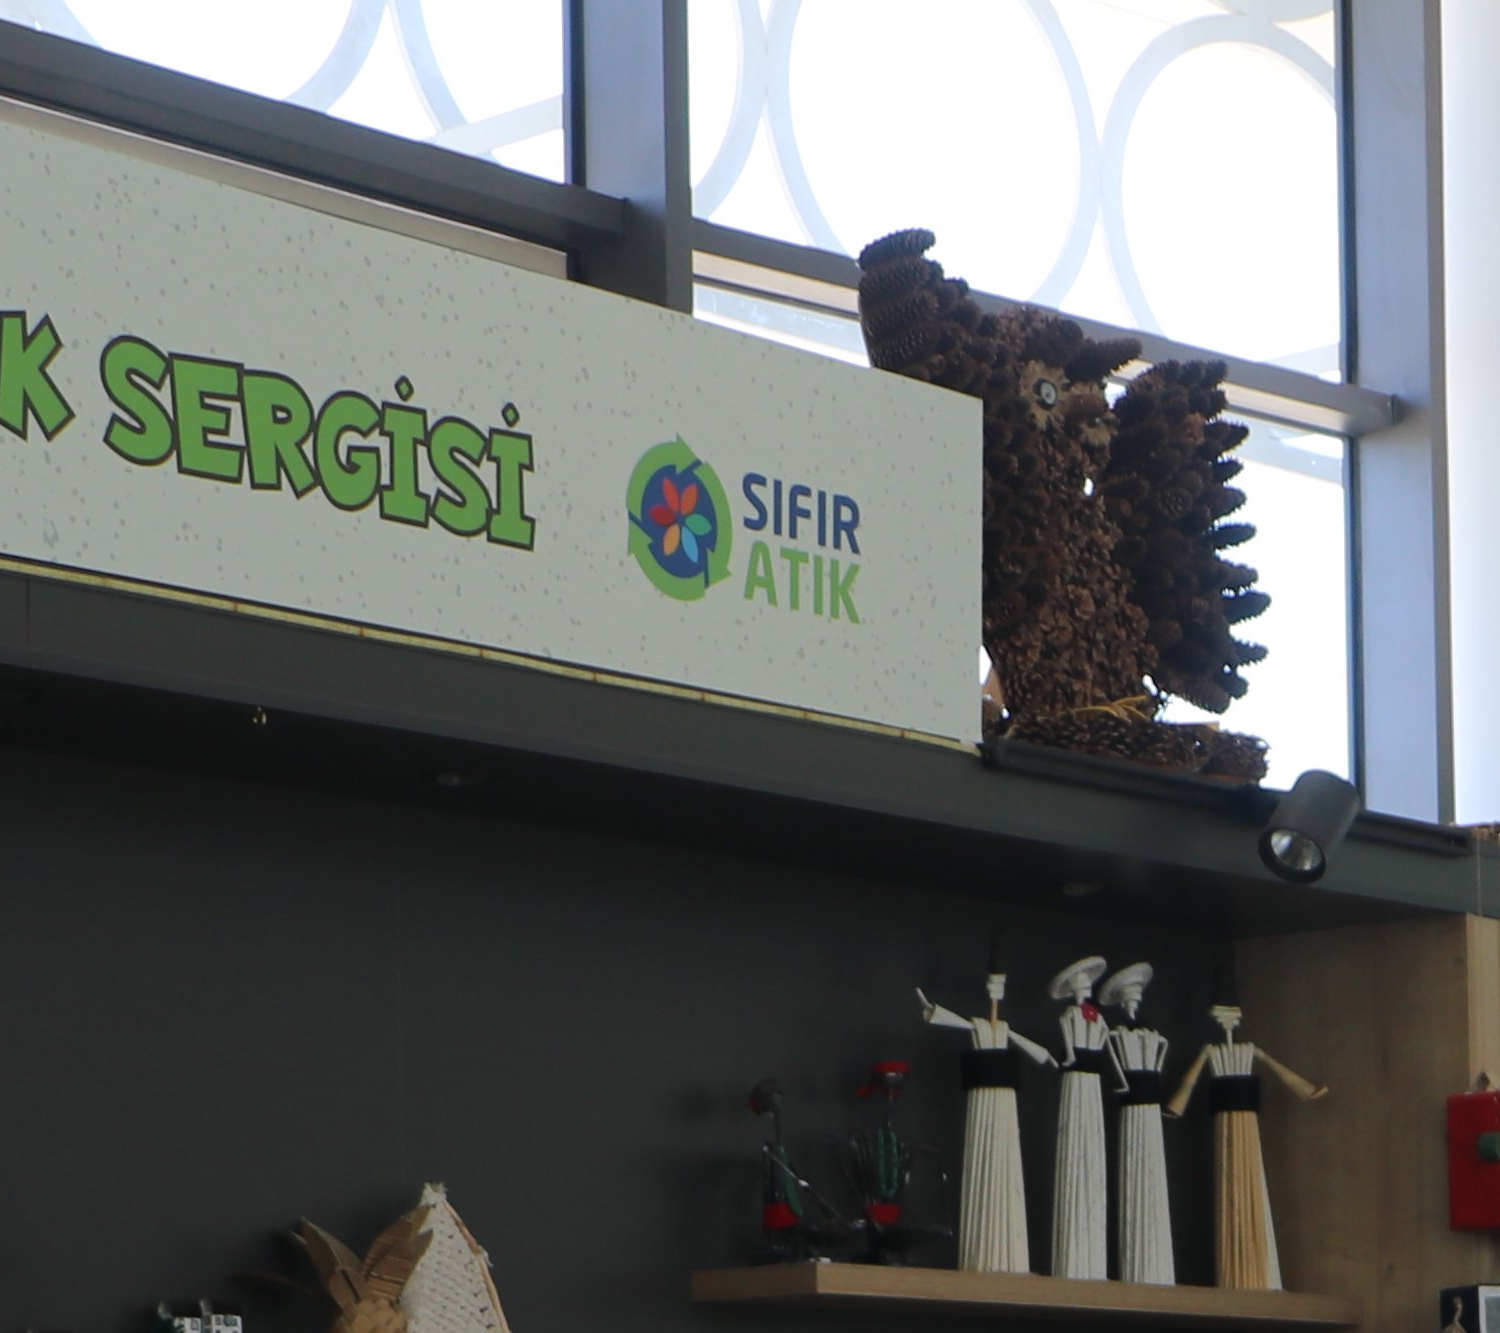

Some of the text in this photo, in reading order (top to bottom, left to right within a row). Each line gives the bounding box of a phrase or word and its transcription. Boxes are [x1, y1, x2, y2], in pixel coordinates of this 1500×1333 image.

[100, 335, 537, 552] SERGİSİ
[740, 471, 863, 556] SIFIR
[743, 539, 864, 624] ATIK
